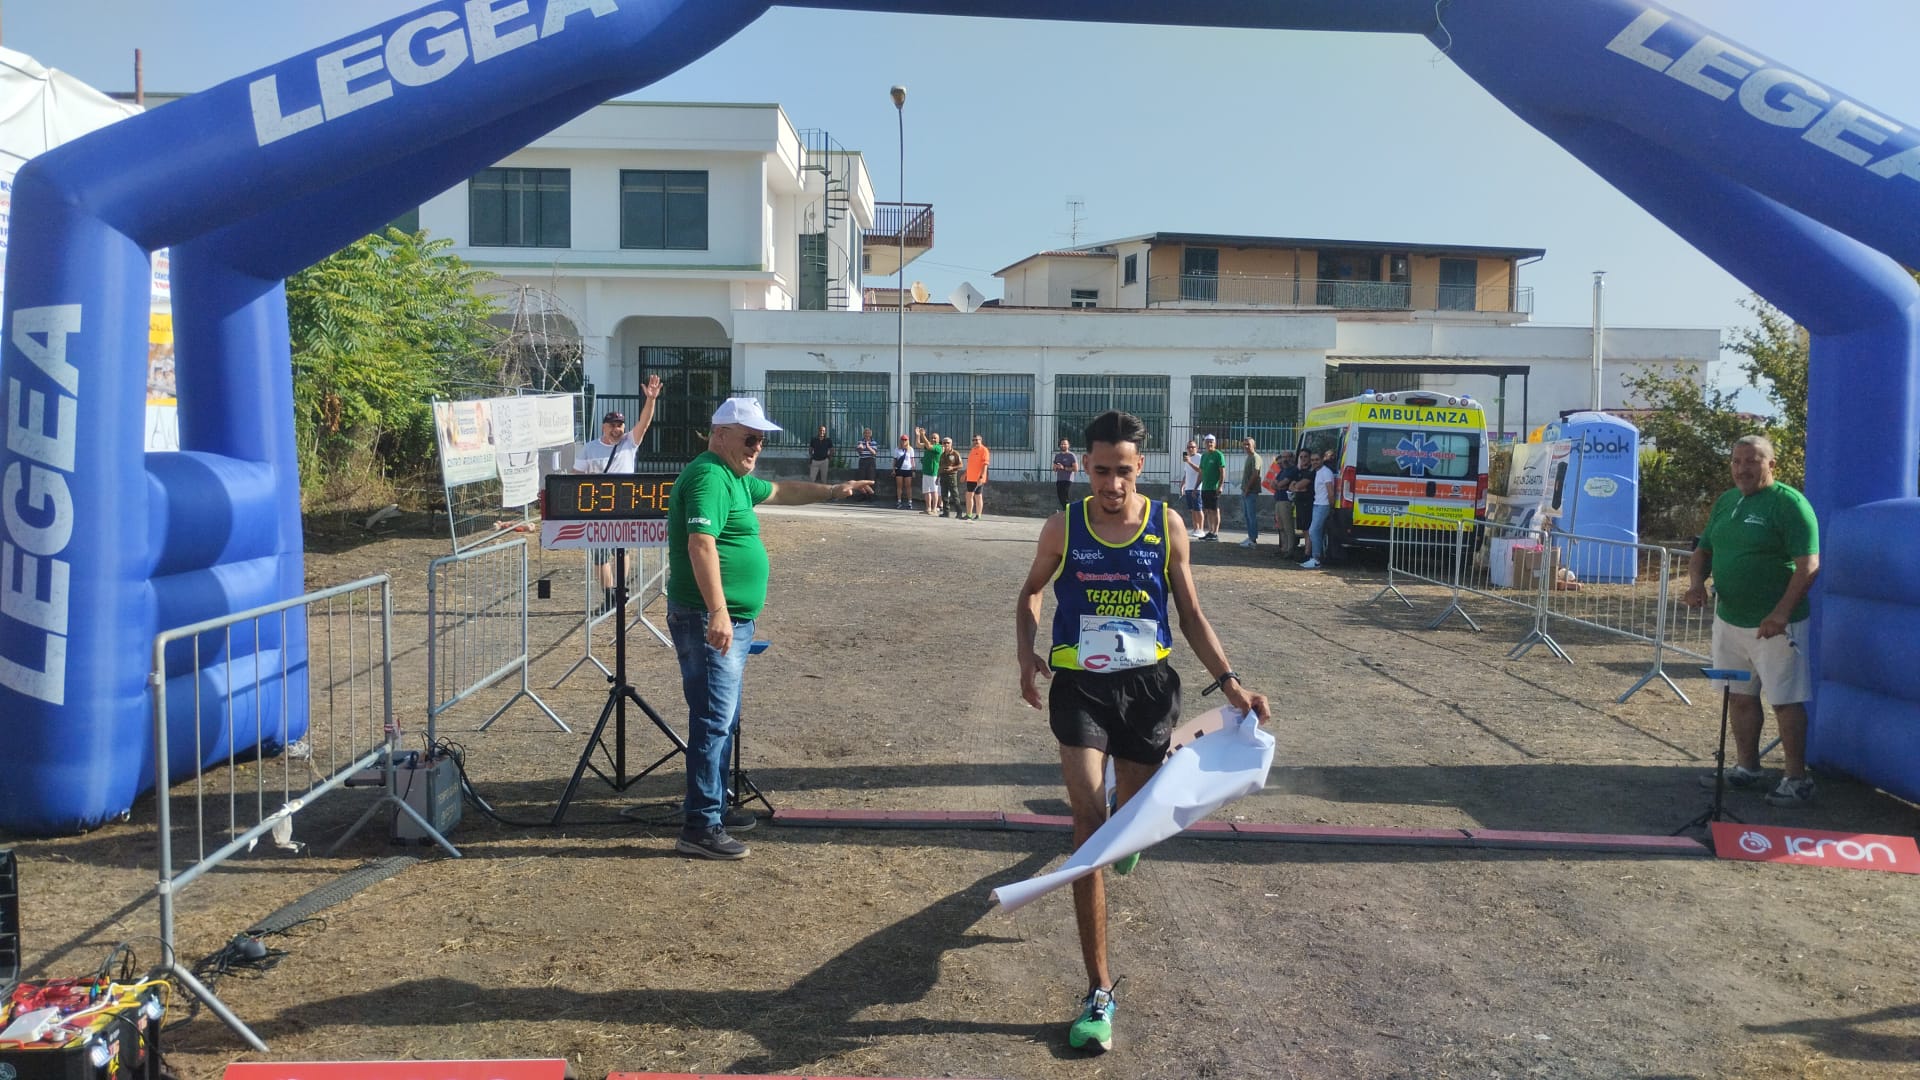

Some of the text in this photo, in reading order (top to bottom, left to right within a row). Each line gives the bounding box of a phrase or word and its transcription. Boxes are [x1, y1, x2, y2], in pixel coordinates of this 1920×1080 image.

[1367, 407, 1469, 424] AMBULANZA
[0, 303, 83, 706] LEGEA
[1072, 549, 1105, 560] Sweet
[1129, 549, 1159, 559] ENERGY
[1136, 558, 1152, 566] GAS
[1086, 589, 1150, 604] TERZIGNO
[1096, 603, 1141, 618] CORRE
[1114, 634, 1126, 653] 1
